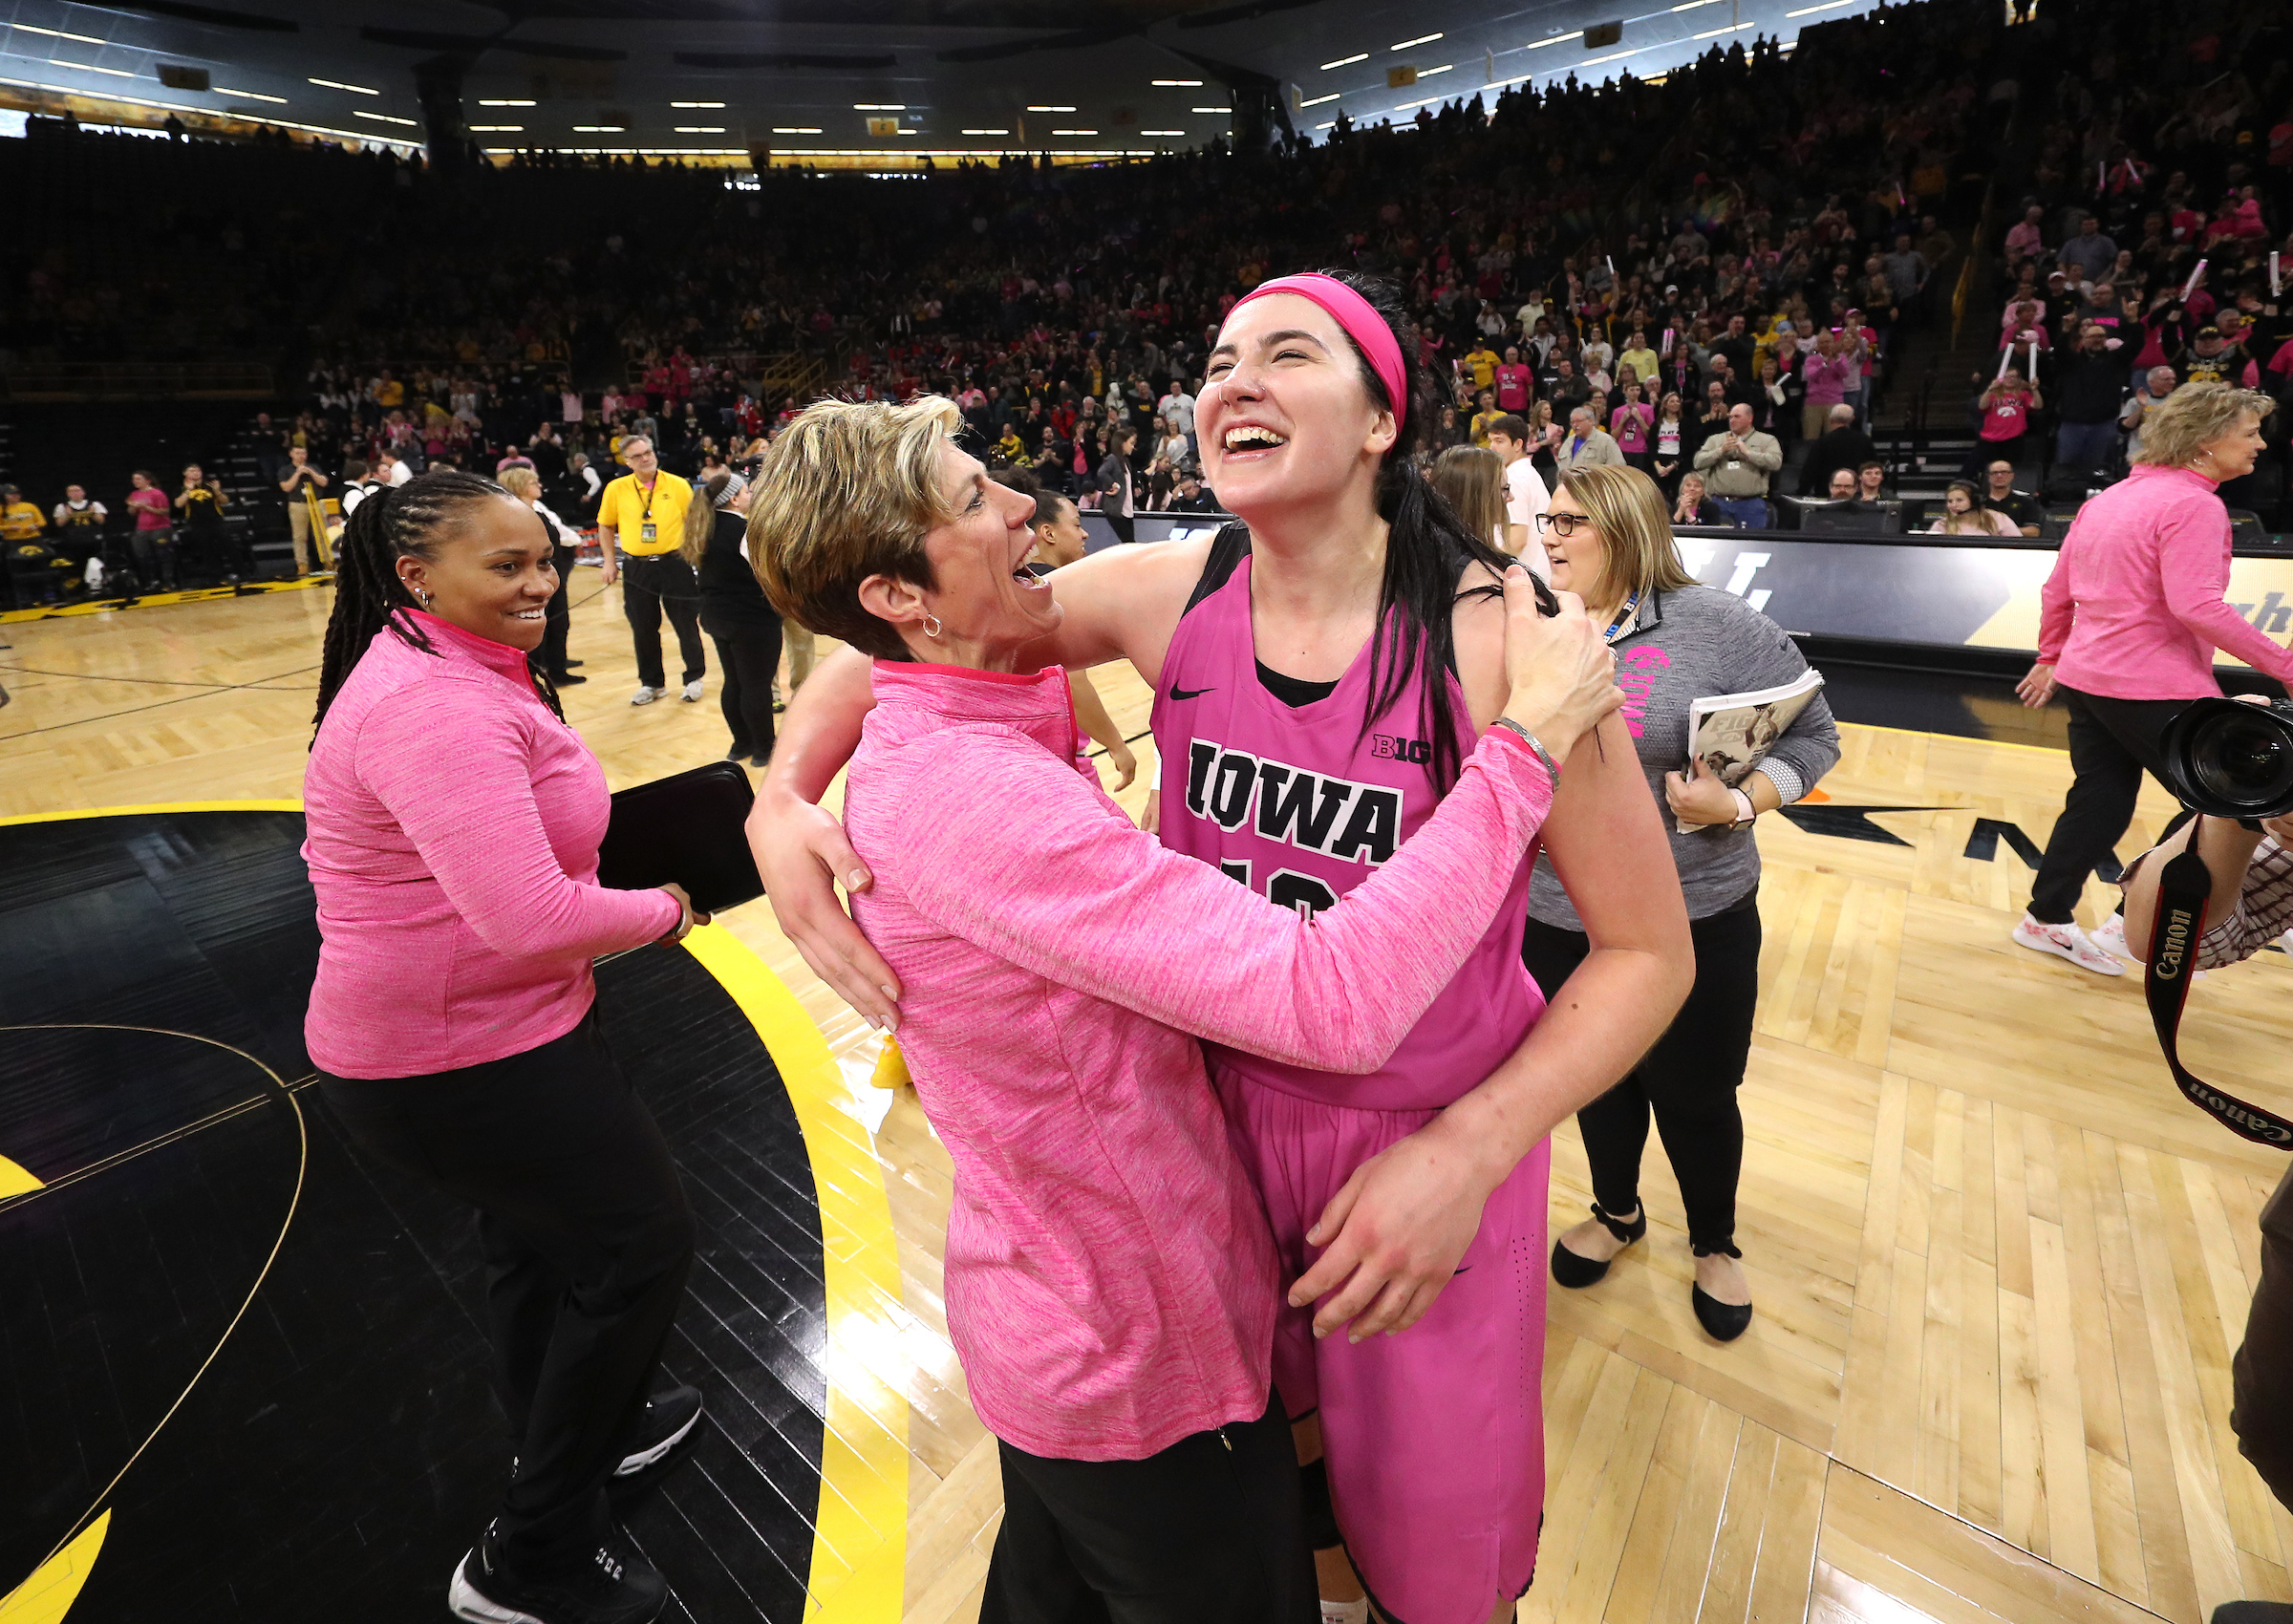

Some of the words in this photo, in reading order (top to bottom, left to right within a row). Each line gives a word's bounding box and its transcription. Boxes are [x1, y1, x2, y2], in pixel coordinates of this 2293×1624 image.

[1186, 737, 1404, 865] IOWA
[2155, 908, 2192, 981] Canon
[2191, 1081, 2292, 1143] Canon
